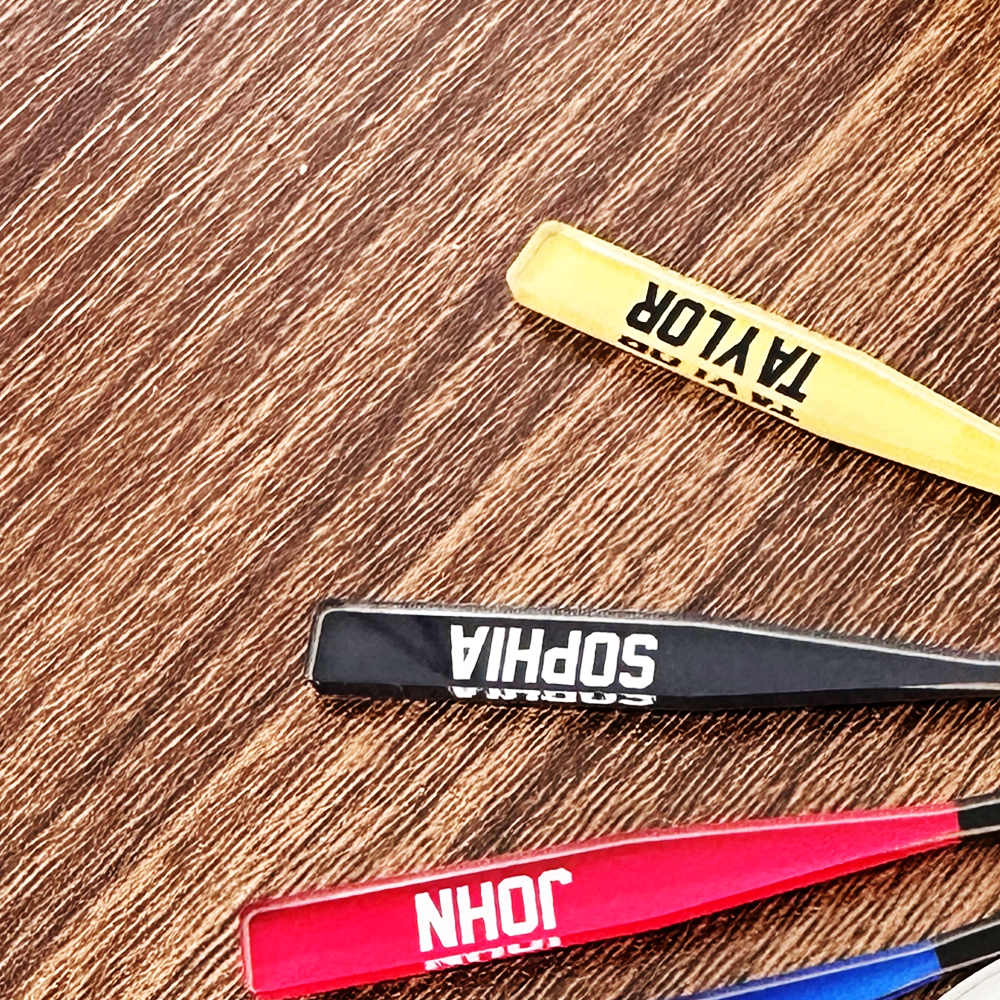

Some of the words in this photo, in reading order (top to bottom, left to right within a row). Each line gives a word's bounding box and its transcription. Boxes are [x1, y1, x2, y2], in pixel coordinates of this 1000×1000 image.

[625, 282, 820, 401] TAYLOR
[450, 624, 658, 689] SOPHIA
[414, 867, 573, 953] JOHN
